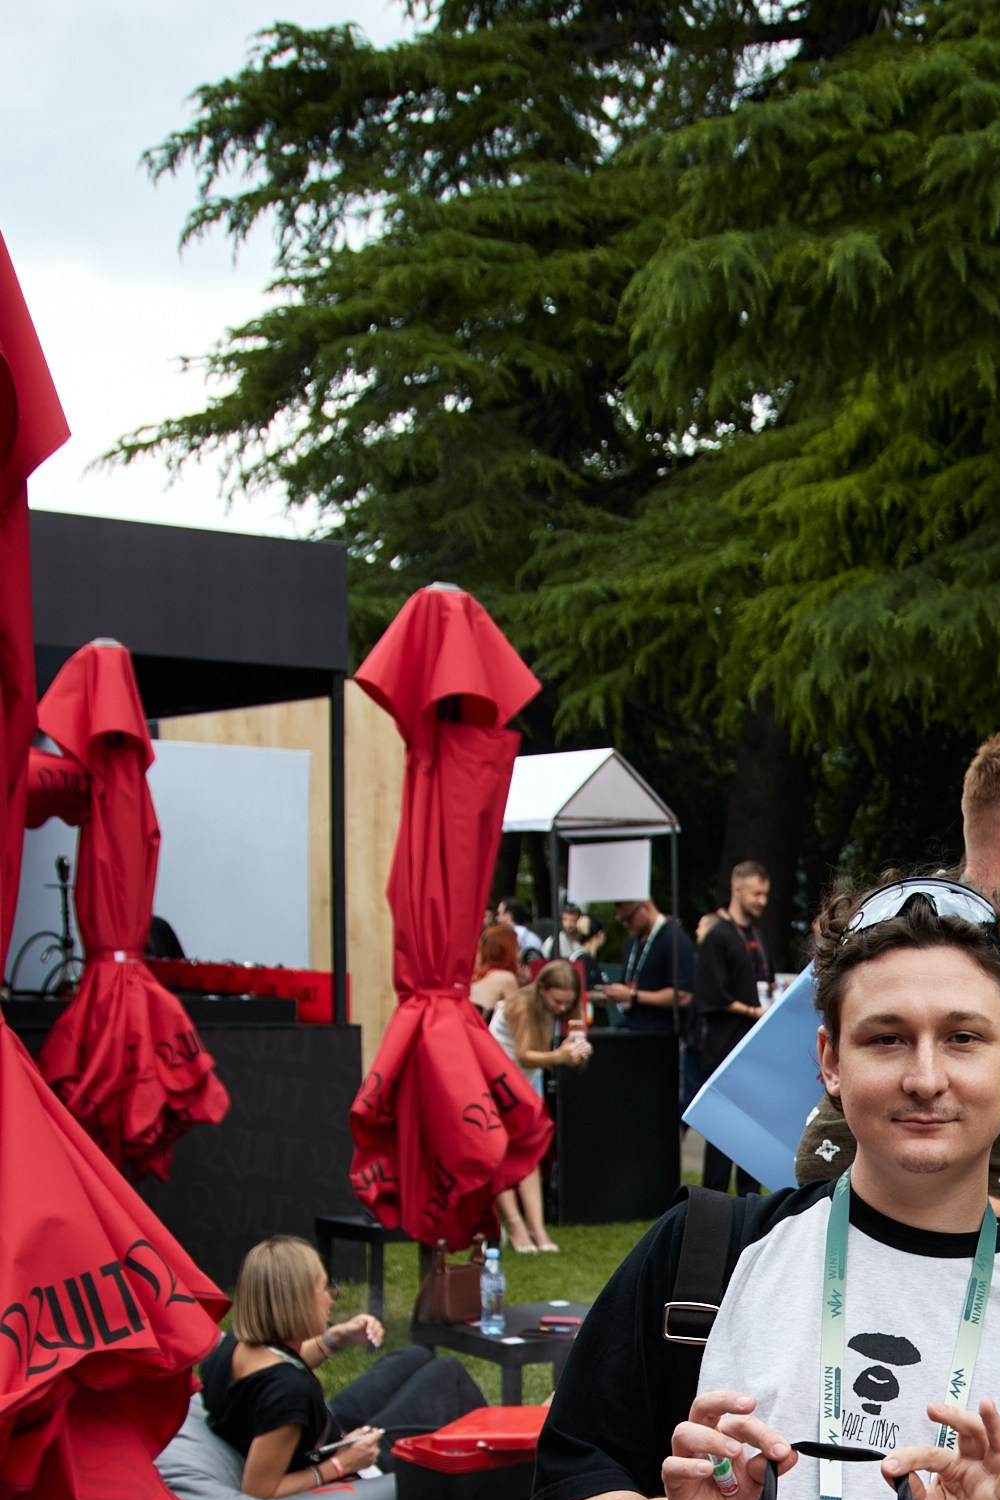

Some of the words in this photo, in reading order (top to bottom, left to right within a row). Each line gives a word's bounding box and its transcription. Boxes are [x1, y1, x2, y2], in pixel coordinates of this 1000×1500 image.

[0, 1261, 146, 1382] KULT
[971, 1279, 988, 1325] WINWIN
[824, 1366, 834, 1418] WINWIN
